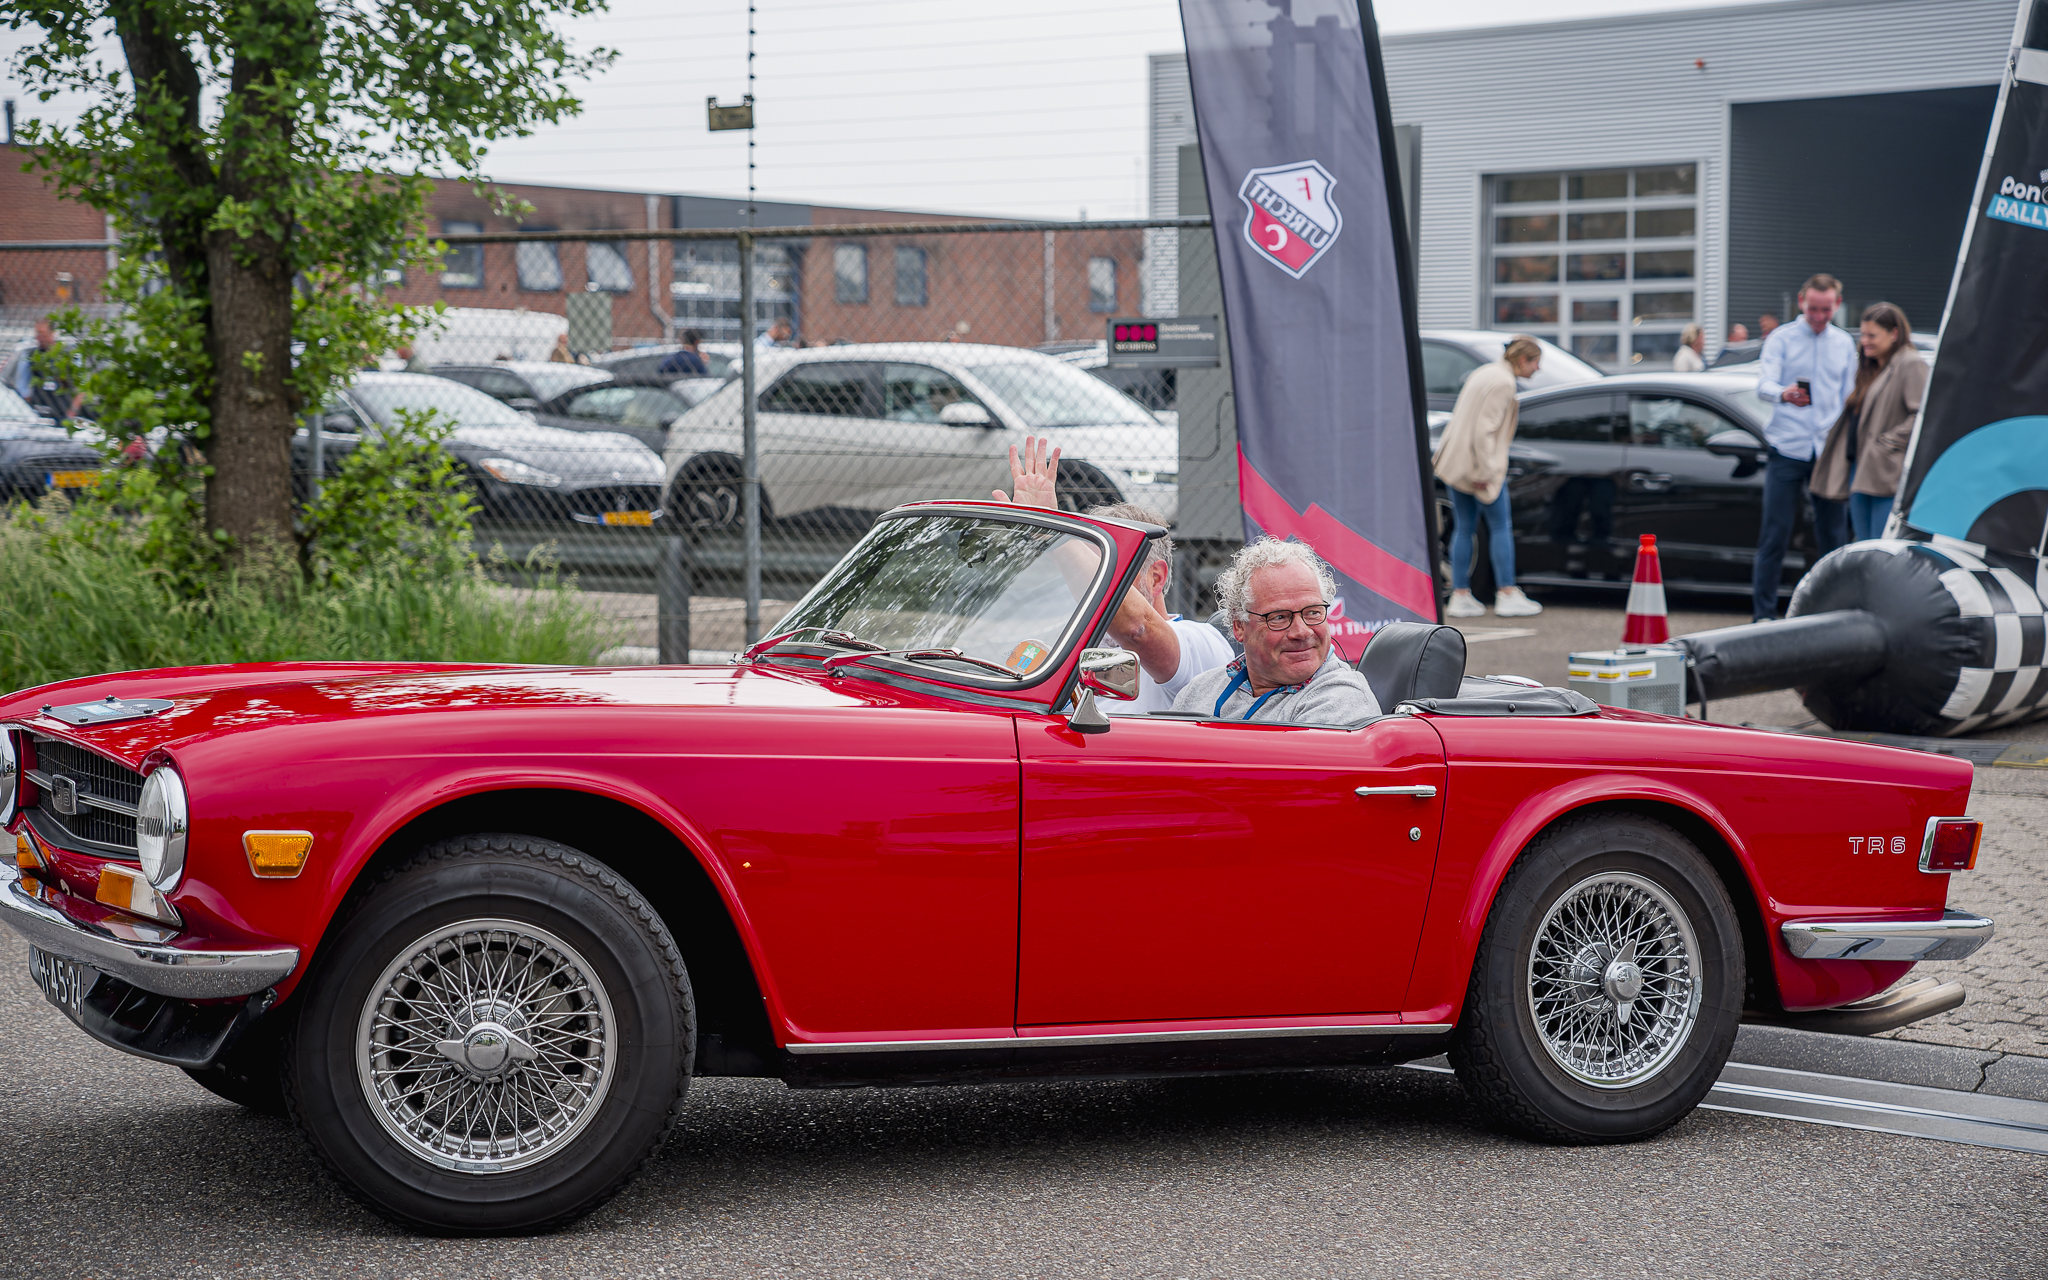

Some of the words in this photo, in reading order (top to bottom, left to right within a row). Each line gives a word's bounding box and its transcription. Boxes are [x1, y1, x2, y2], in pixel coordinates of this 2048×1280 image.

[1115, 341, 1157, 351] SECURITAS
[1848, 836, 1906, 854] TR6
[580, 897, 640, 958] MICHELIN
[33, 945, 83, 1015] H-45-24
